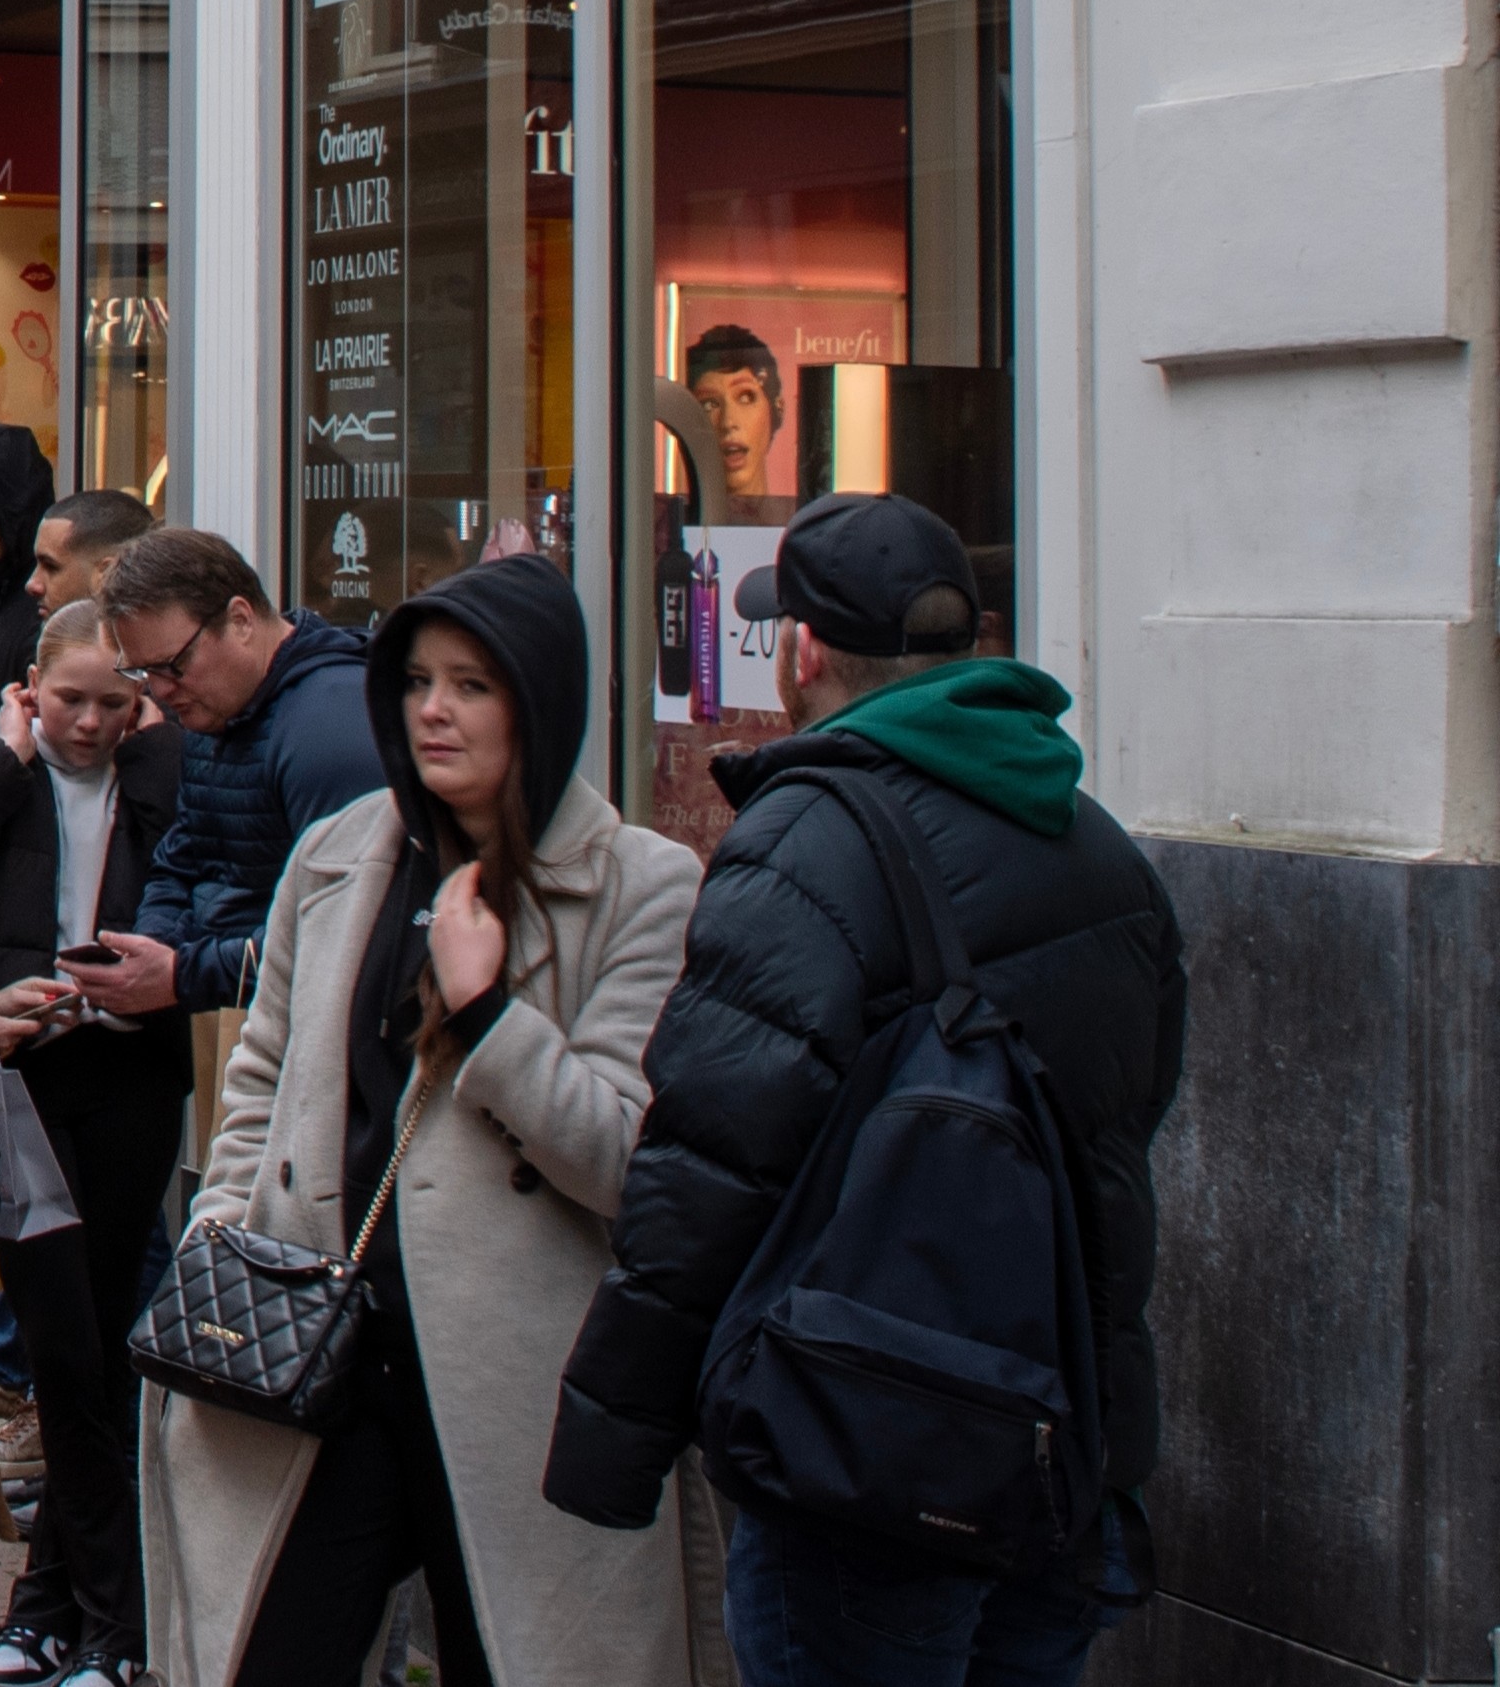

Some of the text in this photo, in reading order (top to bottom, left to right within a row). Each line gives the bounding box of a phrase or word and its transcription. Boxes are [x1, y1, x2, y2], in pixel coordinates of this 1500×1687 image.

[319, 103, 336, 125] The
[319, 121, 388, 167] Ordinary.
[314, 176, 392, 234] LA MER
[307, 247, 400, 287] JO MALONE
[334, 297, 373, 316] LONDON
[315, 332, 391, 373] LA PRAIRIE
[794, 326, 881, 362] benefit
[331, 580, 371, 599] ORIGINS
